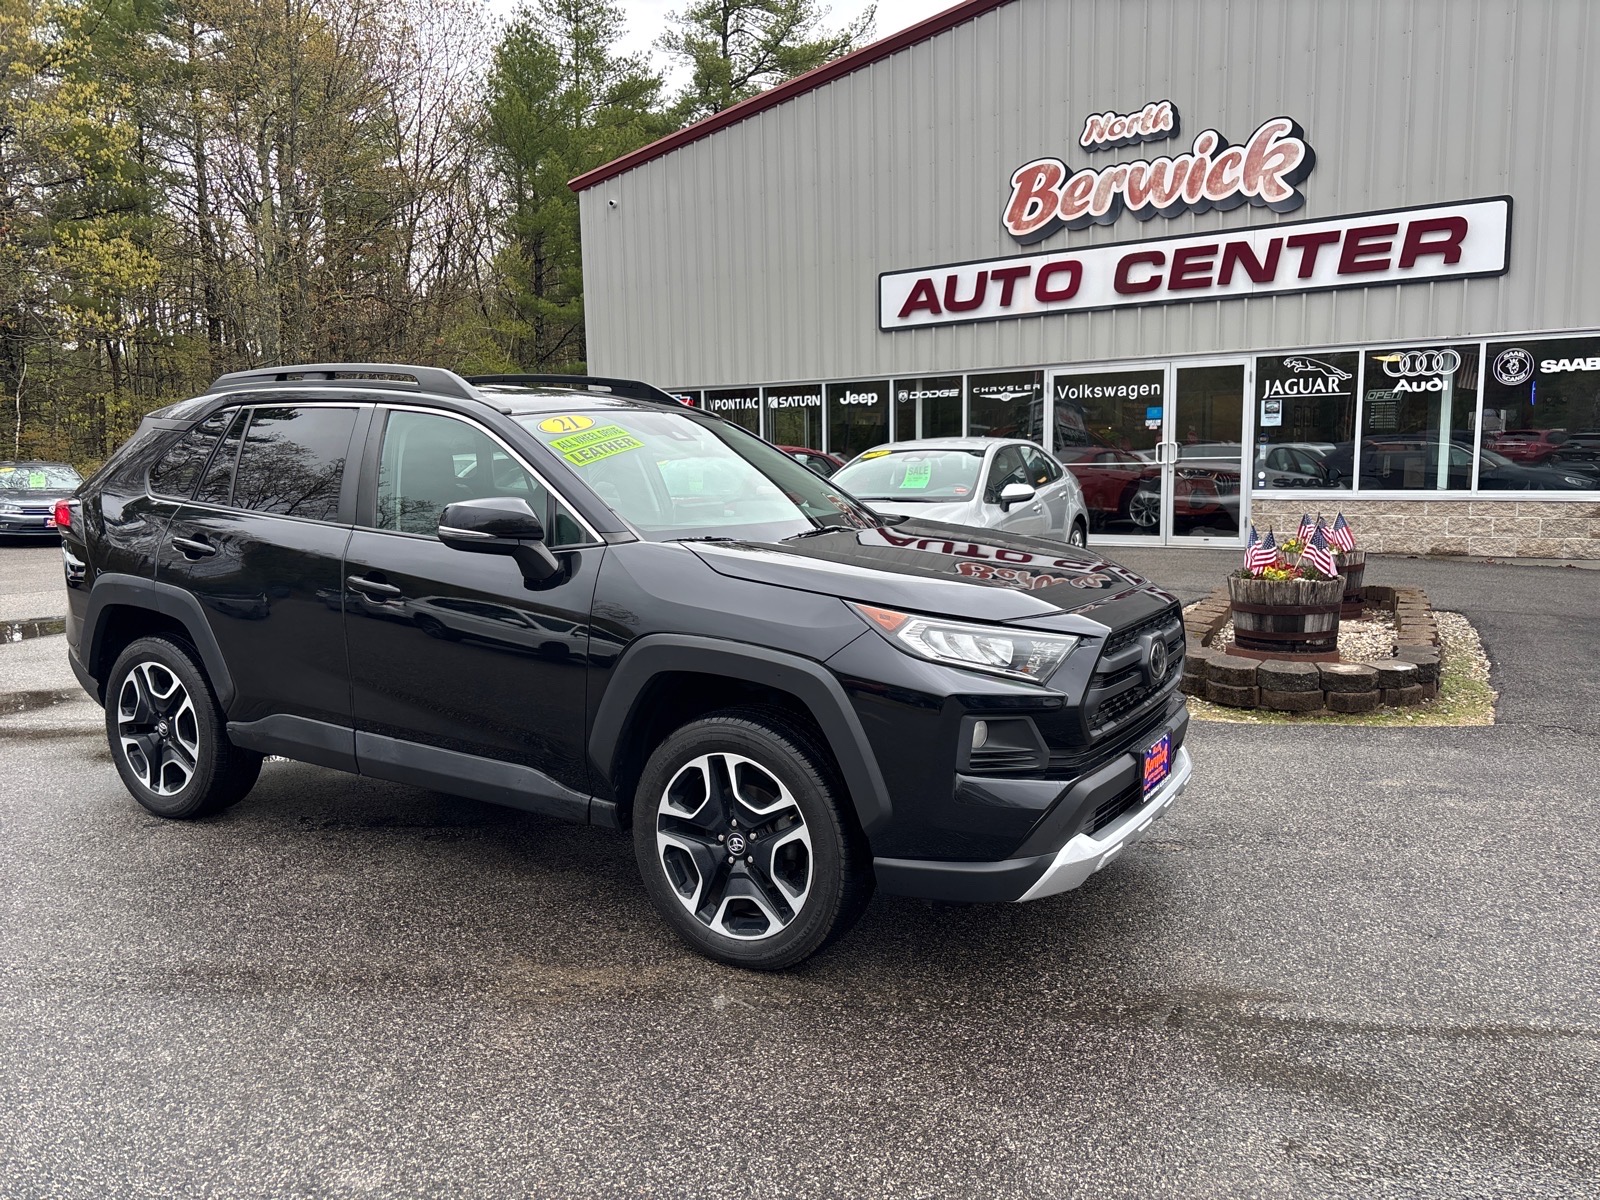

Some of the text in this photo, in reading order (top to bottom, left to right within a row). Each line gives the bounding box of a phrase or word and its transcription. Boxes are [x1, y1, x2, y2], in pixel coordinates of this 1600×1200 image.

[1081, 101, 1178, 150] North
[1003, 118, 1308, 240] Berwick
[897, 215, 1469, 318] AUTO CENTER
[1503, 351, 1525, 359] SAAB
[1539, 357, 1600, 373] SAAB
[972, 384, 1041, 394] CHRYSLER
[1057, 382, 1161, 400] Volkswagen
[1262, 376, 1341, 399] JAGUAR
[1393, 377, 1449, 393] Audi
[778, 395, 821, 408] SATURN
[839, 391, 878, 406] Jeep
[909, 389, 960, 400] DODGE
[1366, 391, 1401, 400] OPEN
[714, 397, 759, 411] PONTIAC
[552, 416, 581, 432] 21
[556, 437, 577, 450] ALL
[573, 431, 600, 445] WHEEL
[569, 437, 636, 463] LEATHER
[907, 466, 929, 476] SALE
